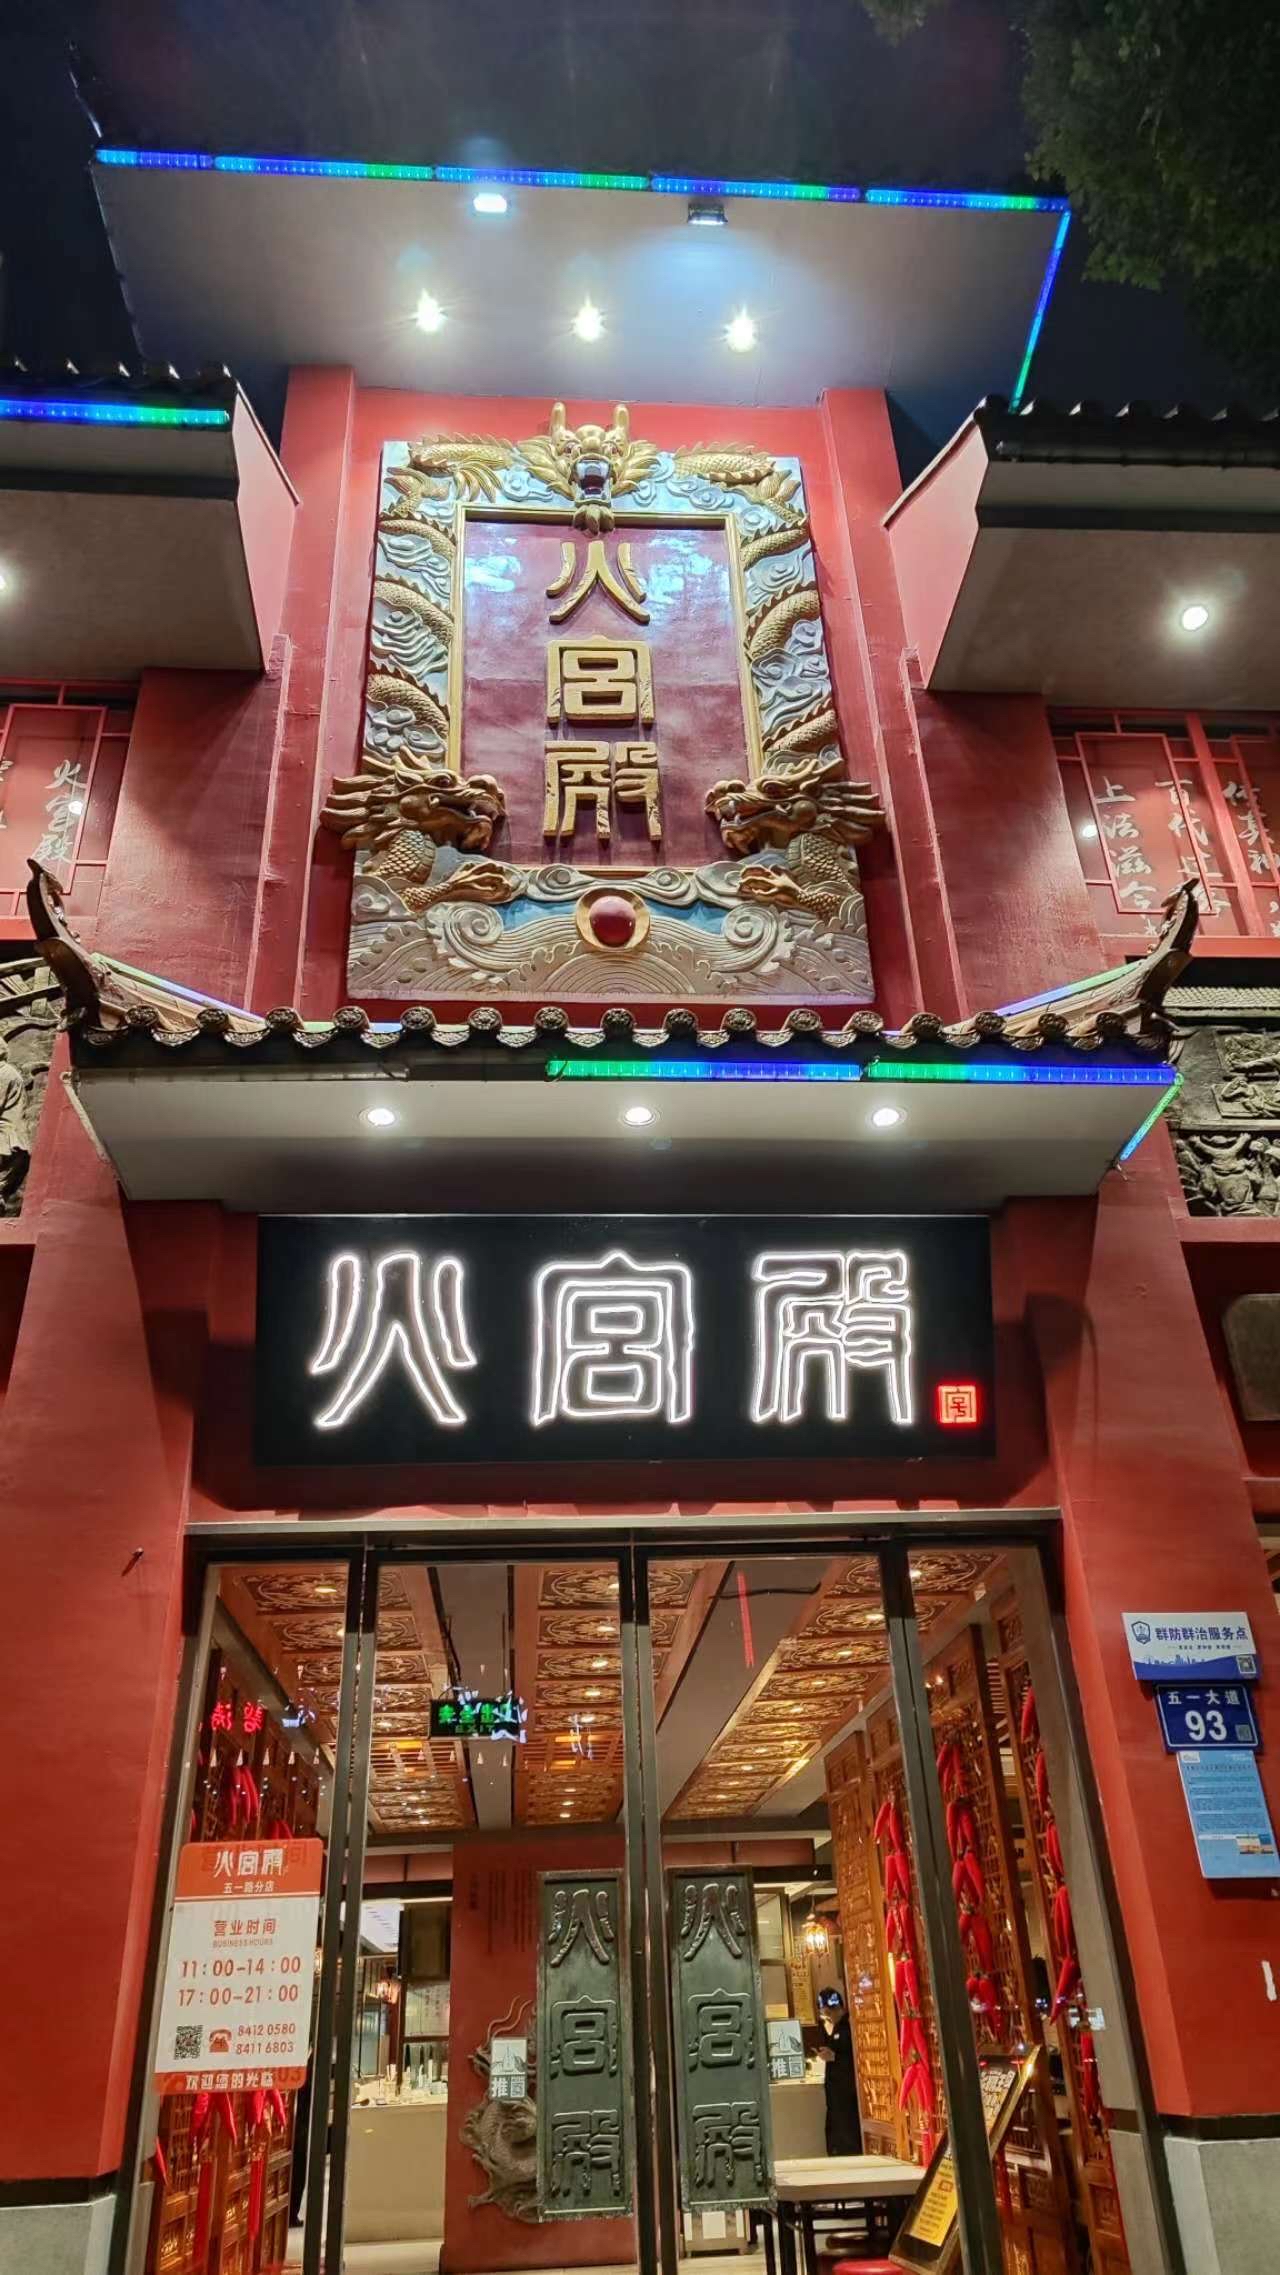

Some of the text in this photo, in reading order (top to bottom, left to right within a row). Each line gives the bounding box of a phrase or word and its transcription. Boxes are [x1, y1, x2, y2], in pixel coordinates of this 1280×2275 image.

[309, 1250, 912, 1427] 火宫殿
[1155, 1626, 1249, 1641] 群防群治服务点
[1167, 1689, 1242, 1705] 五一大道
[1184, 1710, 1228, 1742] 93
[214, 1848, 286, 1877] 火宫殿
[223, 1880, 275, 1894] 五一路分店
[214, 1918, 277, 1936] 营业时间
[185, 2072, 274, 2091] 欢迎您的光临
